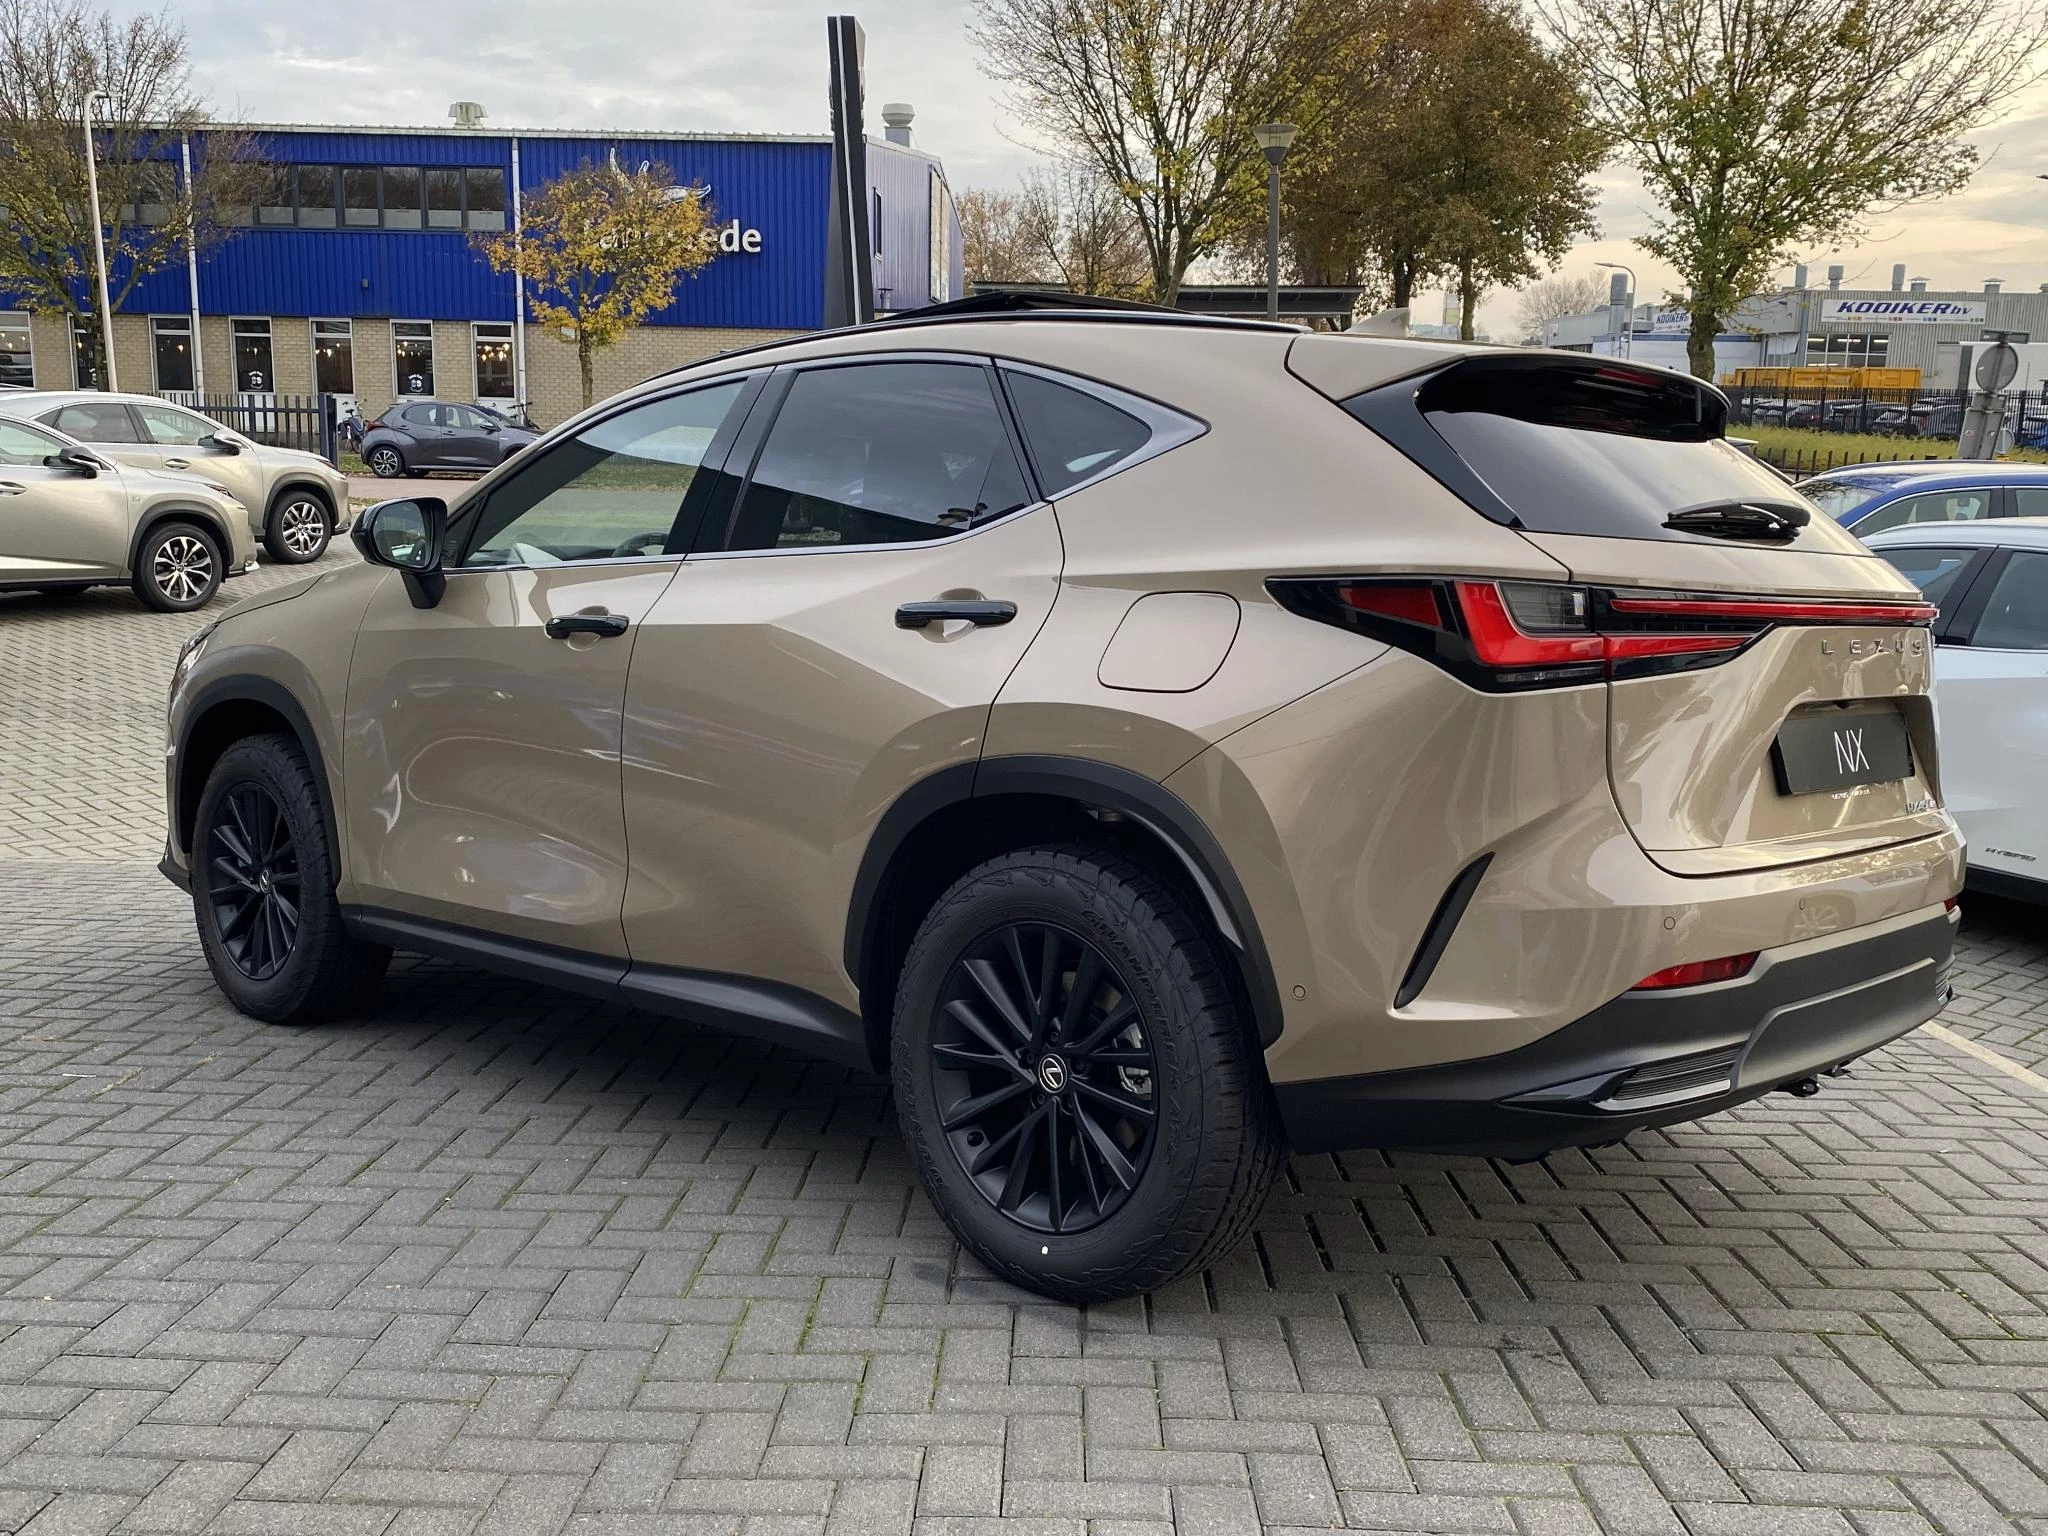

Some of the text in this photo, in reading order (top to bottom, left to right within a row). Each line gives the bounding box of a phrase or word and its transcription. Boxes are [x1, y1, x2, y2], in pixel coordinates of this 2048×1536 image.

[1837, 301, 1951, 314] KOOIKER
[1821, 639, 1925, 657] LEXUS
[1834, 728, 1870, 774] NX
